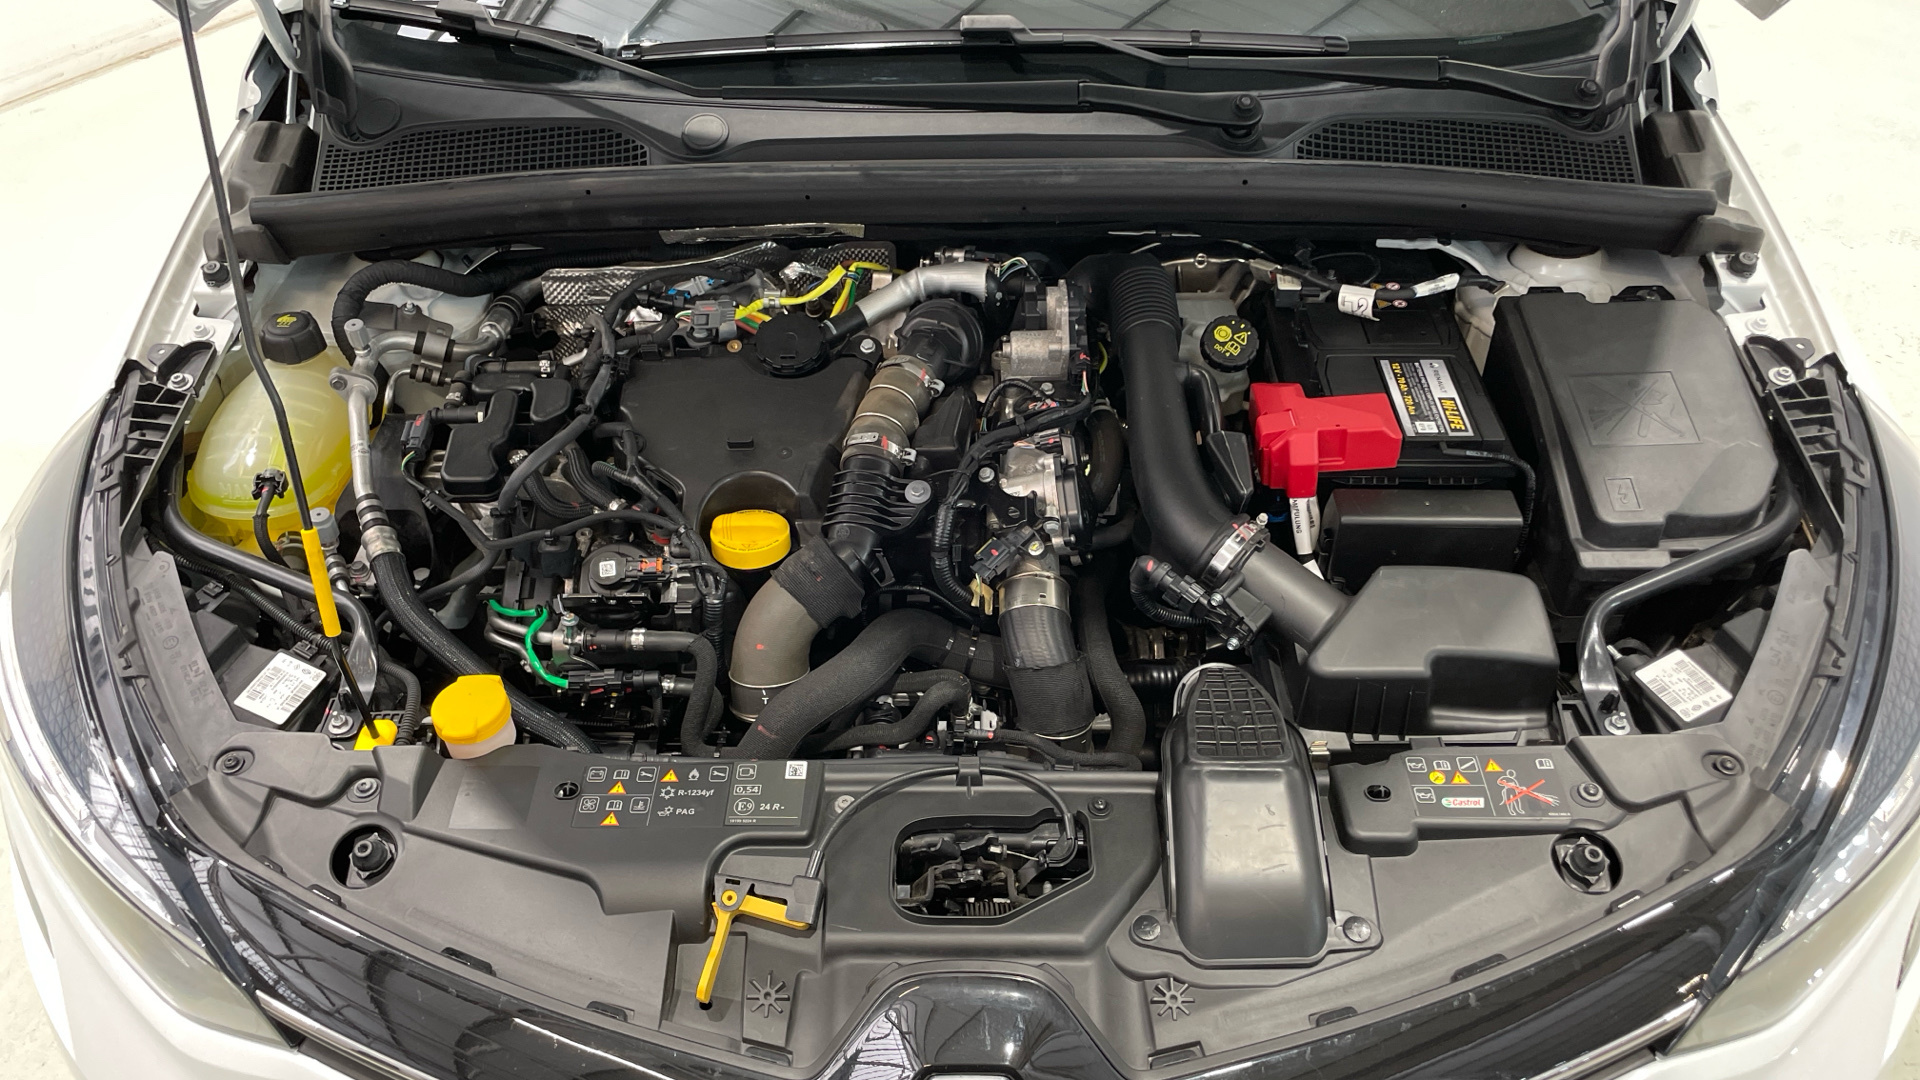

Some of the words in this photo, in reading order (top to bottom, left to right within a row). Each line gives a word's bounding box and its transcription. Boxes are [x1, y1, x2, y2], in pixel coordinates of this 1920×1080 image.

[1433, 369, 1448, 393] RENAULT
[677, 789, 714, 797] R-1234yf
[736, 786, 759, 794] 0,54
[1452, 798, 1482, 806] Castrol
[759, 803, 771, 811] 24
